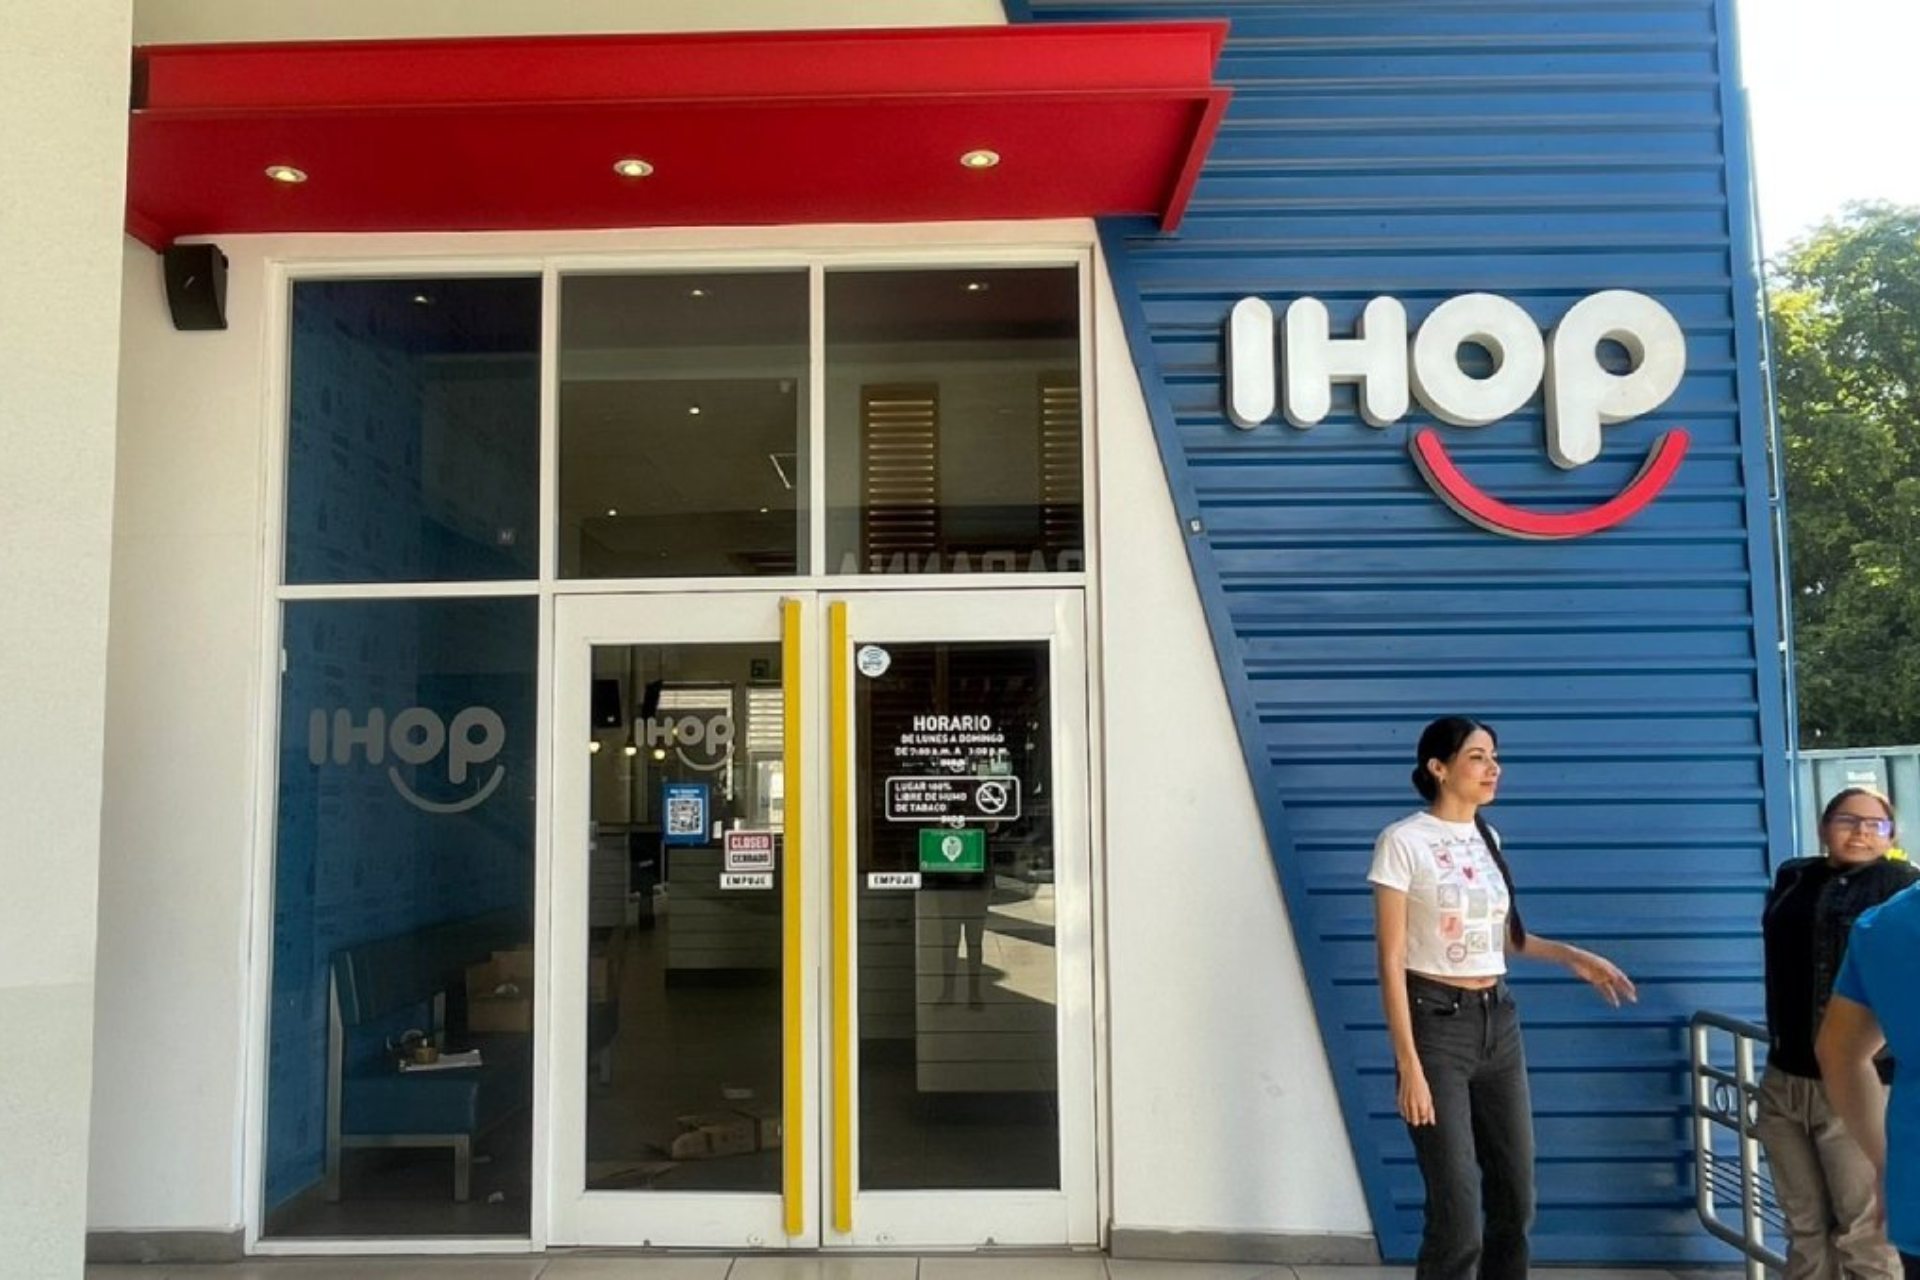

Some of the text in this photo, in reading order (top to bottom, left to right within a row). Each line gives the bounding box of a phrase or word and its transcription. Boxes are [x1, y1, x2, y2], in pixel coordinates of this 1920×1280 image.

[1226, 289, 1687, 469] IHOP
[913, 715, 991, 732] HORARIO
[635, 715, 735, 756] IHOP
[901, 733, 1005, 744] DE LUNES A DOMINGO
[308, 706, 505, 784] IHOP
[895, 747, 908, 757] DE
[894, 781, 926, 791] LUGAR
[894, 792, 967, 802] LIBRE DE HUMO
[895, 803, 947, 812] DE TABACO
[732, 835, 769, 849] CLOSED
[726, 876, 766, 885] EMPUJE
[874, 875, 913, 884] EMPUJE
